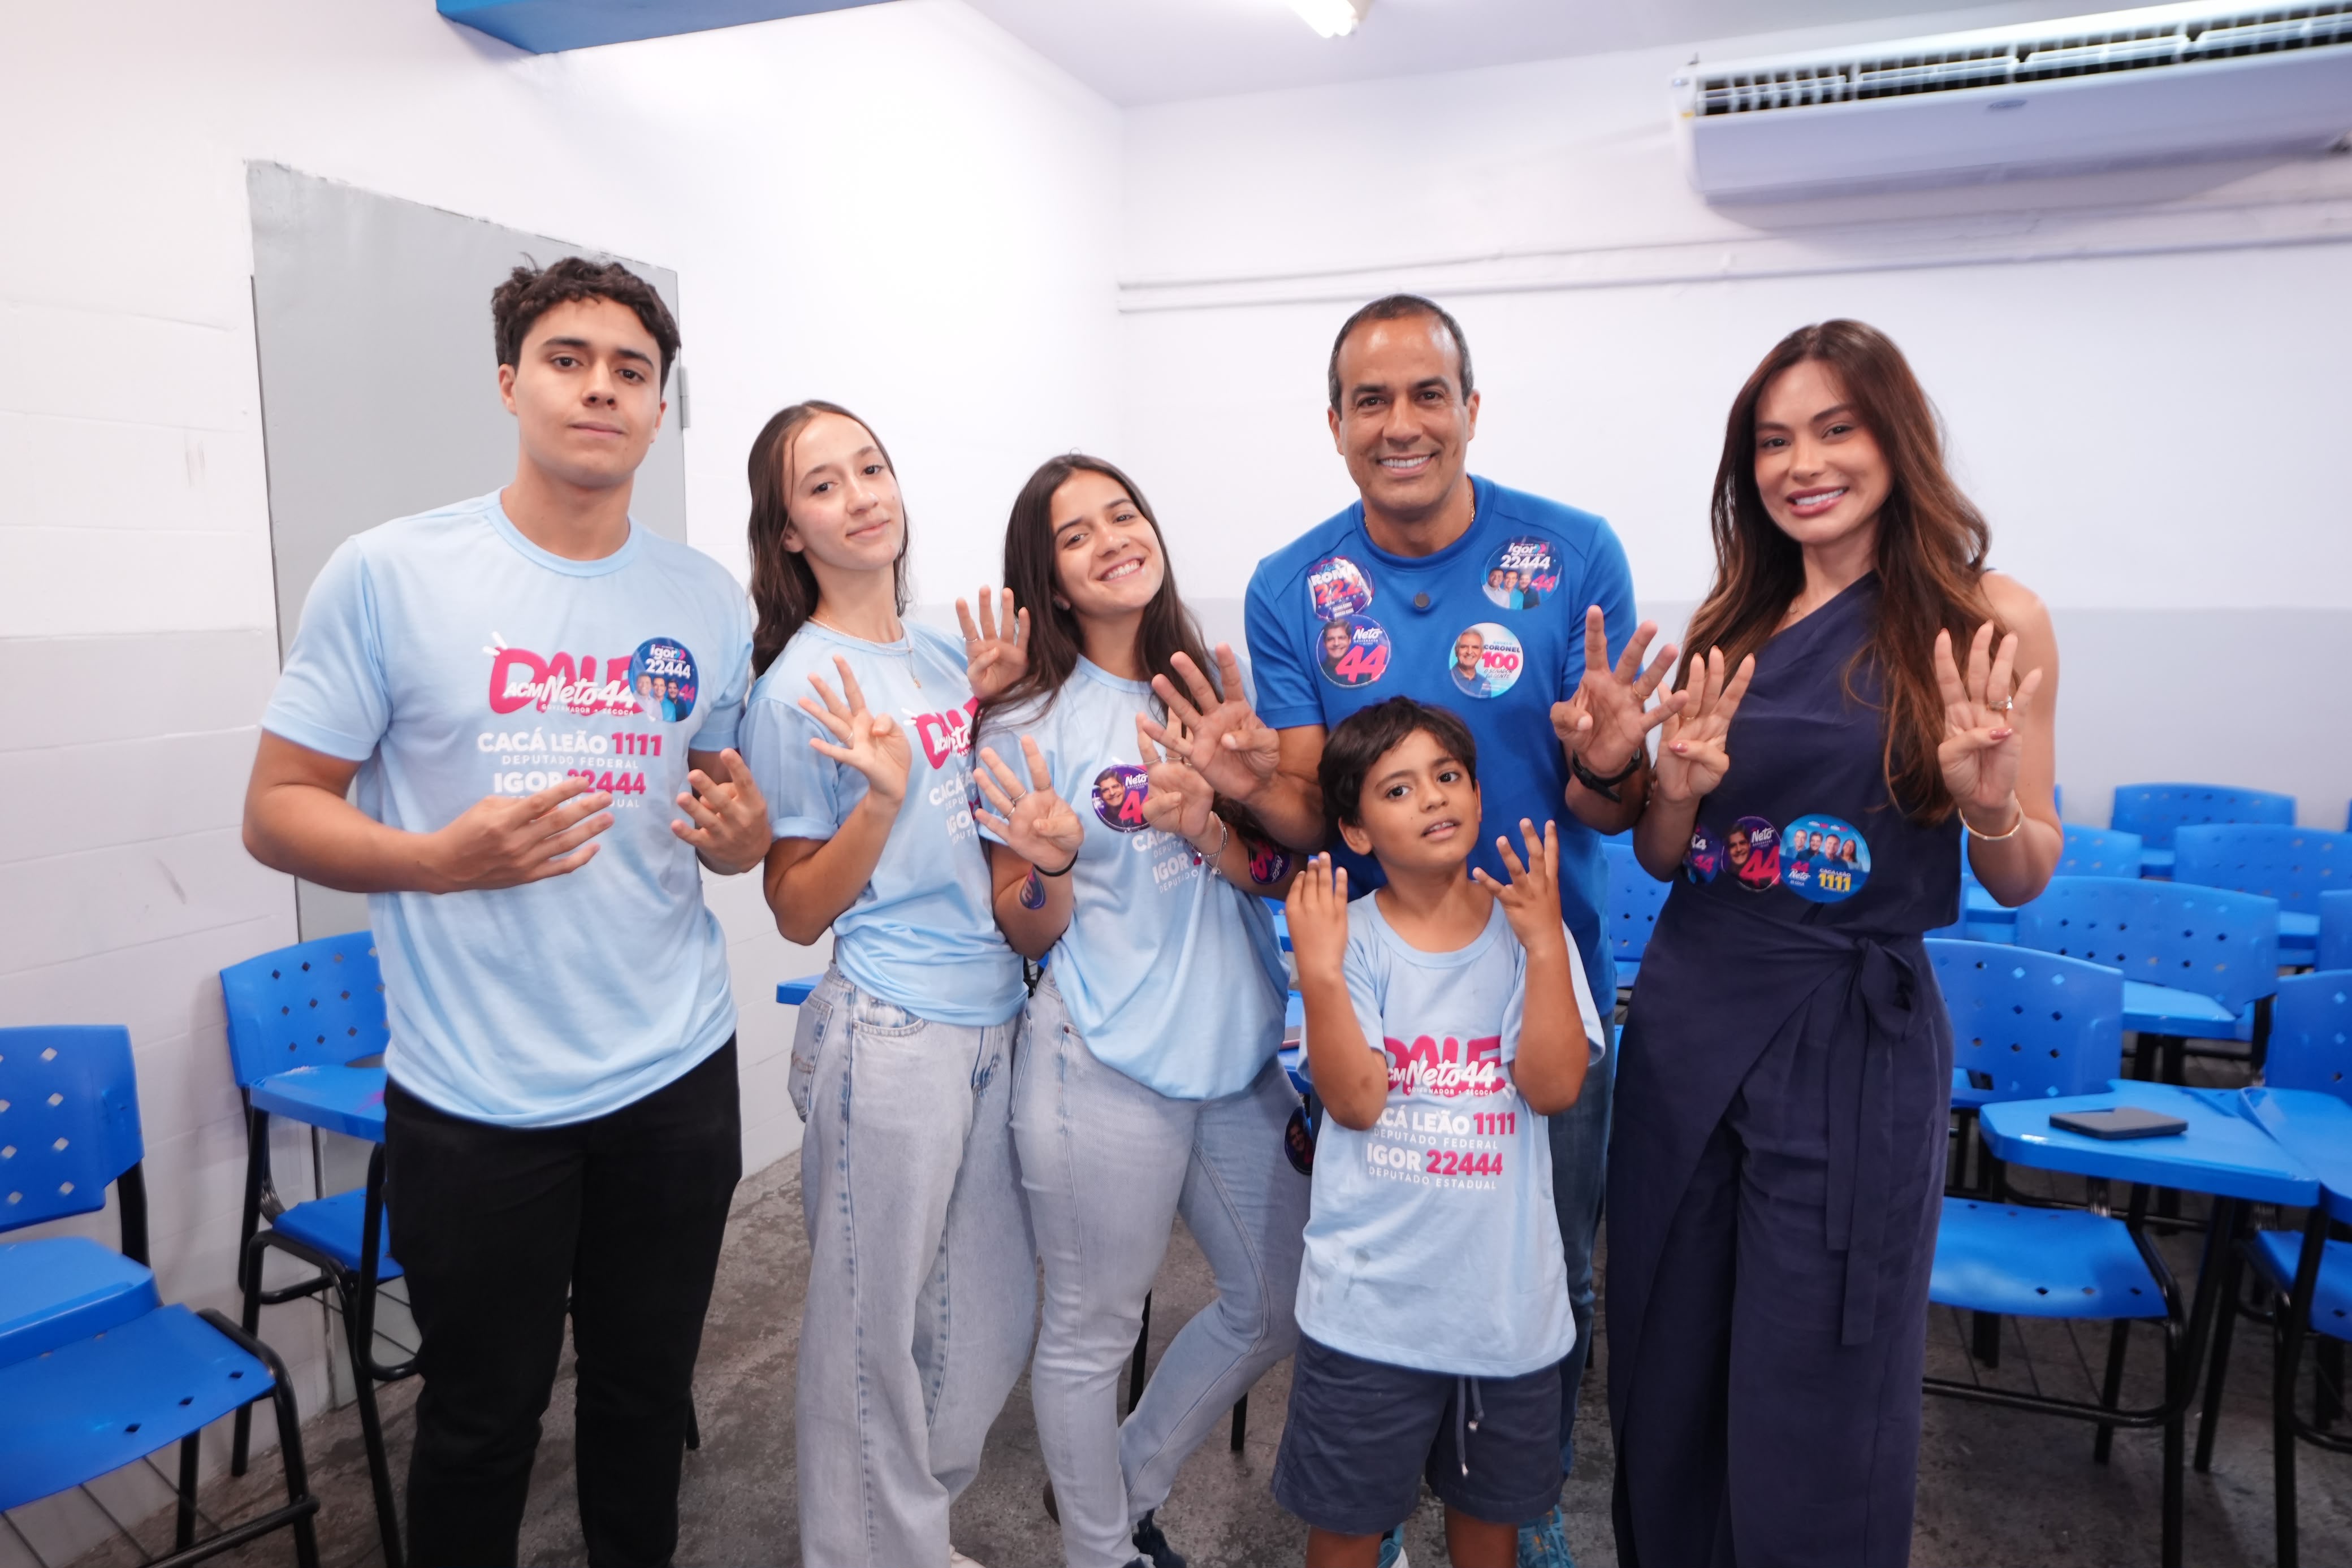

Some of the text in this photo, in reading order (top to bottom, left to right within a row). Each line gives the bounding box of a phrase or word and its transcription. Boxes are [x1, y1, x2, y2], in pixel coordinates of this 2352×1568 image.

[1500, 555, 1551, 570] 22444
[1311, 564, 1357, 586] ROM
[1532, 574, 1557, 592] 44
[1353, 627, 1382, 639] Neto
[646, 658, 690, 679] 22444
[1335, 645, 1387, 683] 44
[1482, 651, 1519, 670] 100
[503, 675, 636, 708] ACM Neto 44
[680, 683, 695, 703] 44
[542, 704, 590, 713] GOVERNADOR
[478, 726, 662, 756] CACÁ LEÃO 1111
[502, 755, 638, 769] DEPUTADO FEDERAL
[1126, 773, 1148, 786] Neto
[1118, 790, 1149, 824] 4
[946, 810, 974, 835] IGO
[1752, 828, 1774, 843] Neto
[1154, 840, 1183, 858] DEPUTA
[1152, 852, 1189, 884] IGOR
[1739, 845, 1780, 887] 44
[1788, 870, 1811, 880] Neto
[1791, 860, 1809, 873] 44
[1819, 873, 1851, 891] 1111
[1387, 1059, 1496, 1088] CM Neto 44
[1376, 1104, 1515, 1136] CÁ LEÃO 1111
[1374, 1128, 1498, 1150] DEPUTADO FEDERAL
[1367, 1142, 1503, 1176] IGOR 22444
[1369, 1166, 1497, 1190] DEPUTADO ESTADUAL
